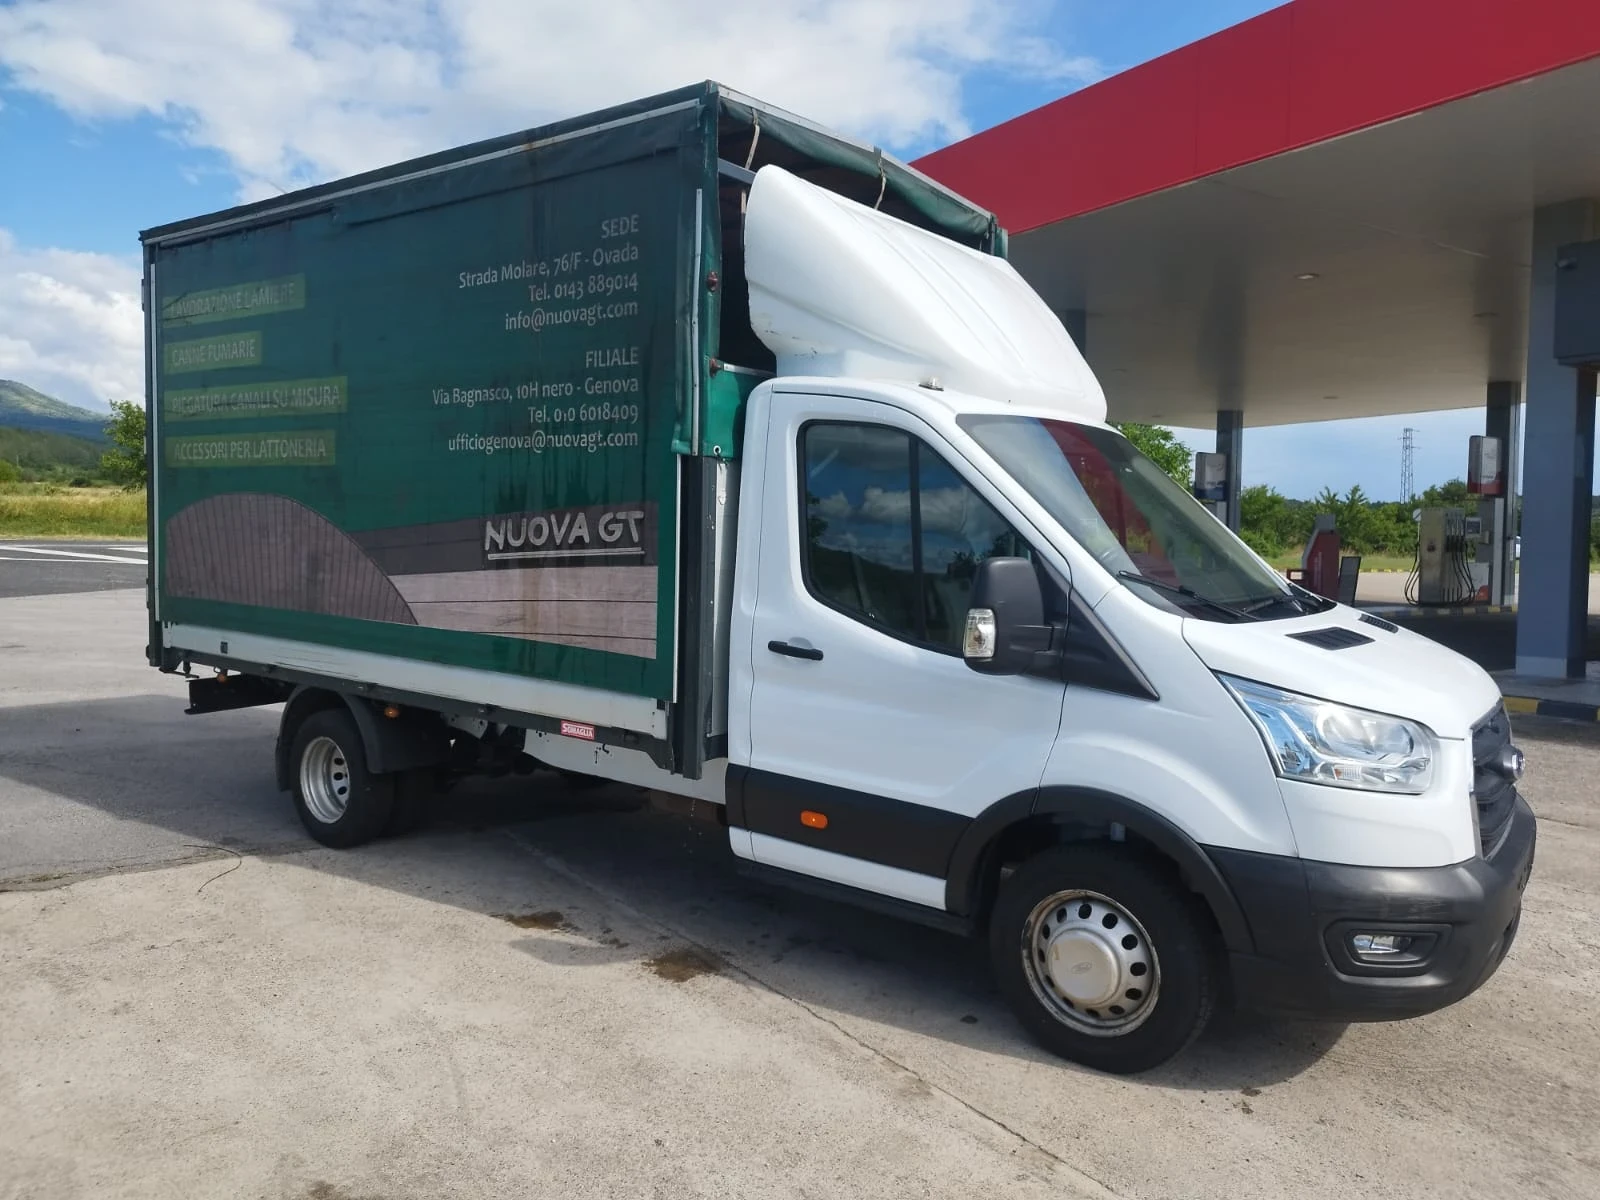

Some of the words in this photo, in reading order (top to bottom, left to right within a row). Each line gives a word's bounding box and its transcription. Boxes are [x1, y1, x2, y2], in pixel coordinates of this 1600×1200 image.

[600, 214, 639, 238] SEDE
[459, 267, 498, 289] Strada
[501, 260, 550, 282] Molare,
[553, 251, 582, 276] 76/F
[592, 243, 639, 266] Ovada
[528, 284, 551, 302] Tel.
[554, 280, 584, 300] 0143
[588, 272, 639, 295] 889014
[505, 301, 639, 332] info@nuovagt.com
[585, 347, 639, 368] FILIALE
[432, 387, 450, 405] Via
[452, 387, 513, 408] Bagnasco,
[516, 381, 539, 399] 10H
[542, 381, 574, 398] nero
[584, 377, 639, 395] Genova
[528, 406, 551, 423] Tel.
[553, 407, 576, 423] 010
[579, 402, 639, 424] 6018409
[174, 440, 229, 461] ACCESSORI
[230, 439, 251, 460] PER
[253, 436, 327, 459] LATTONERIA
[448, 430, 639, 454] ufficiogenova@nuovagt.com
[485, 512, 590, 551] NUOVA
[598, 510, 645, 544] GT
